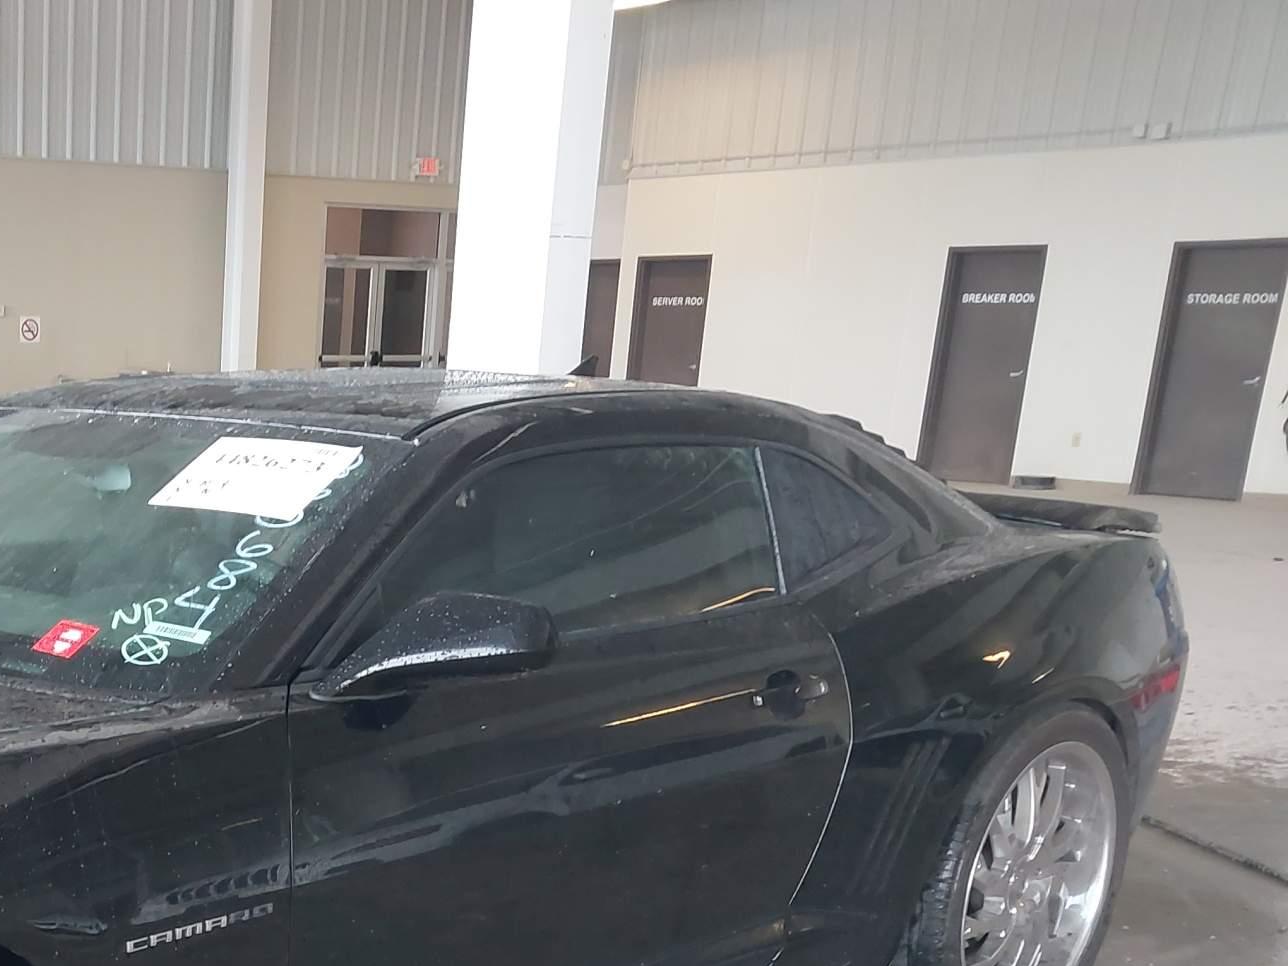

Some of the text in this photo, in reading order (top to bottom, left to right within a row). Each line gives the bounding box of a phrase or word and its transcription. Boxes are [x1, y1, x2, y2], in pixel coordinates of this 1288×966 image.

[652, 296, 705, 306] SERVER ROO
[961, 292, 1007, 304] BREAKER
[1186, 292, 1279, 305] STORAGE ROOM
[126, 902, 274, 953] CAMARO
